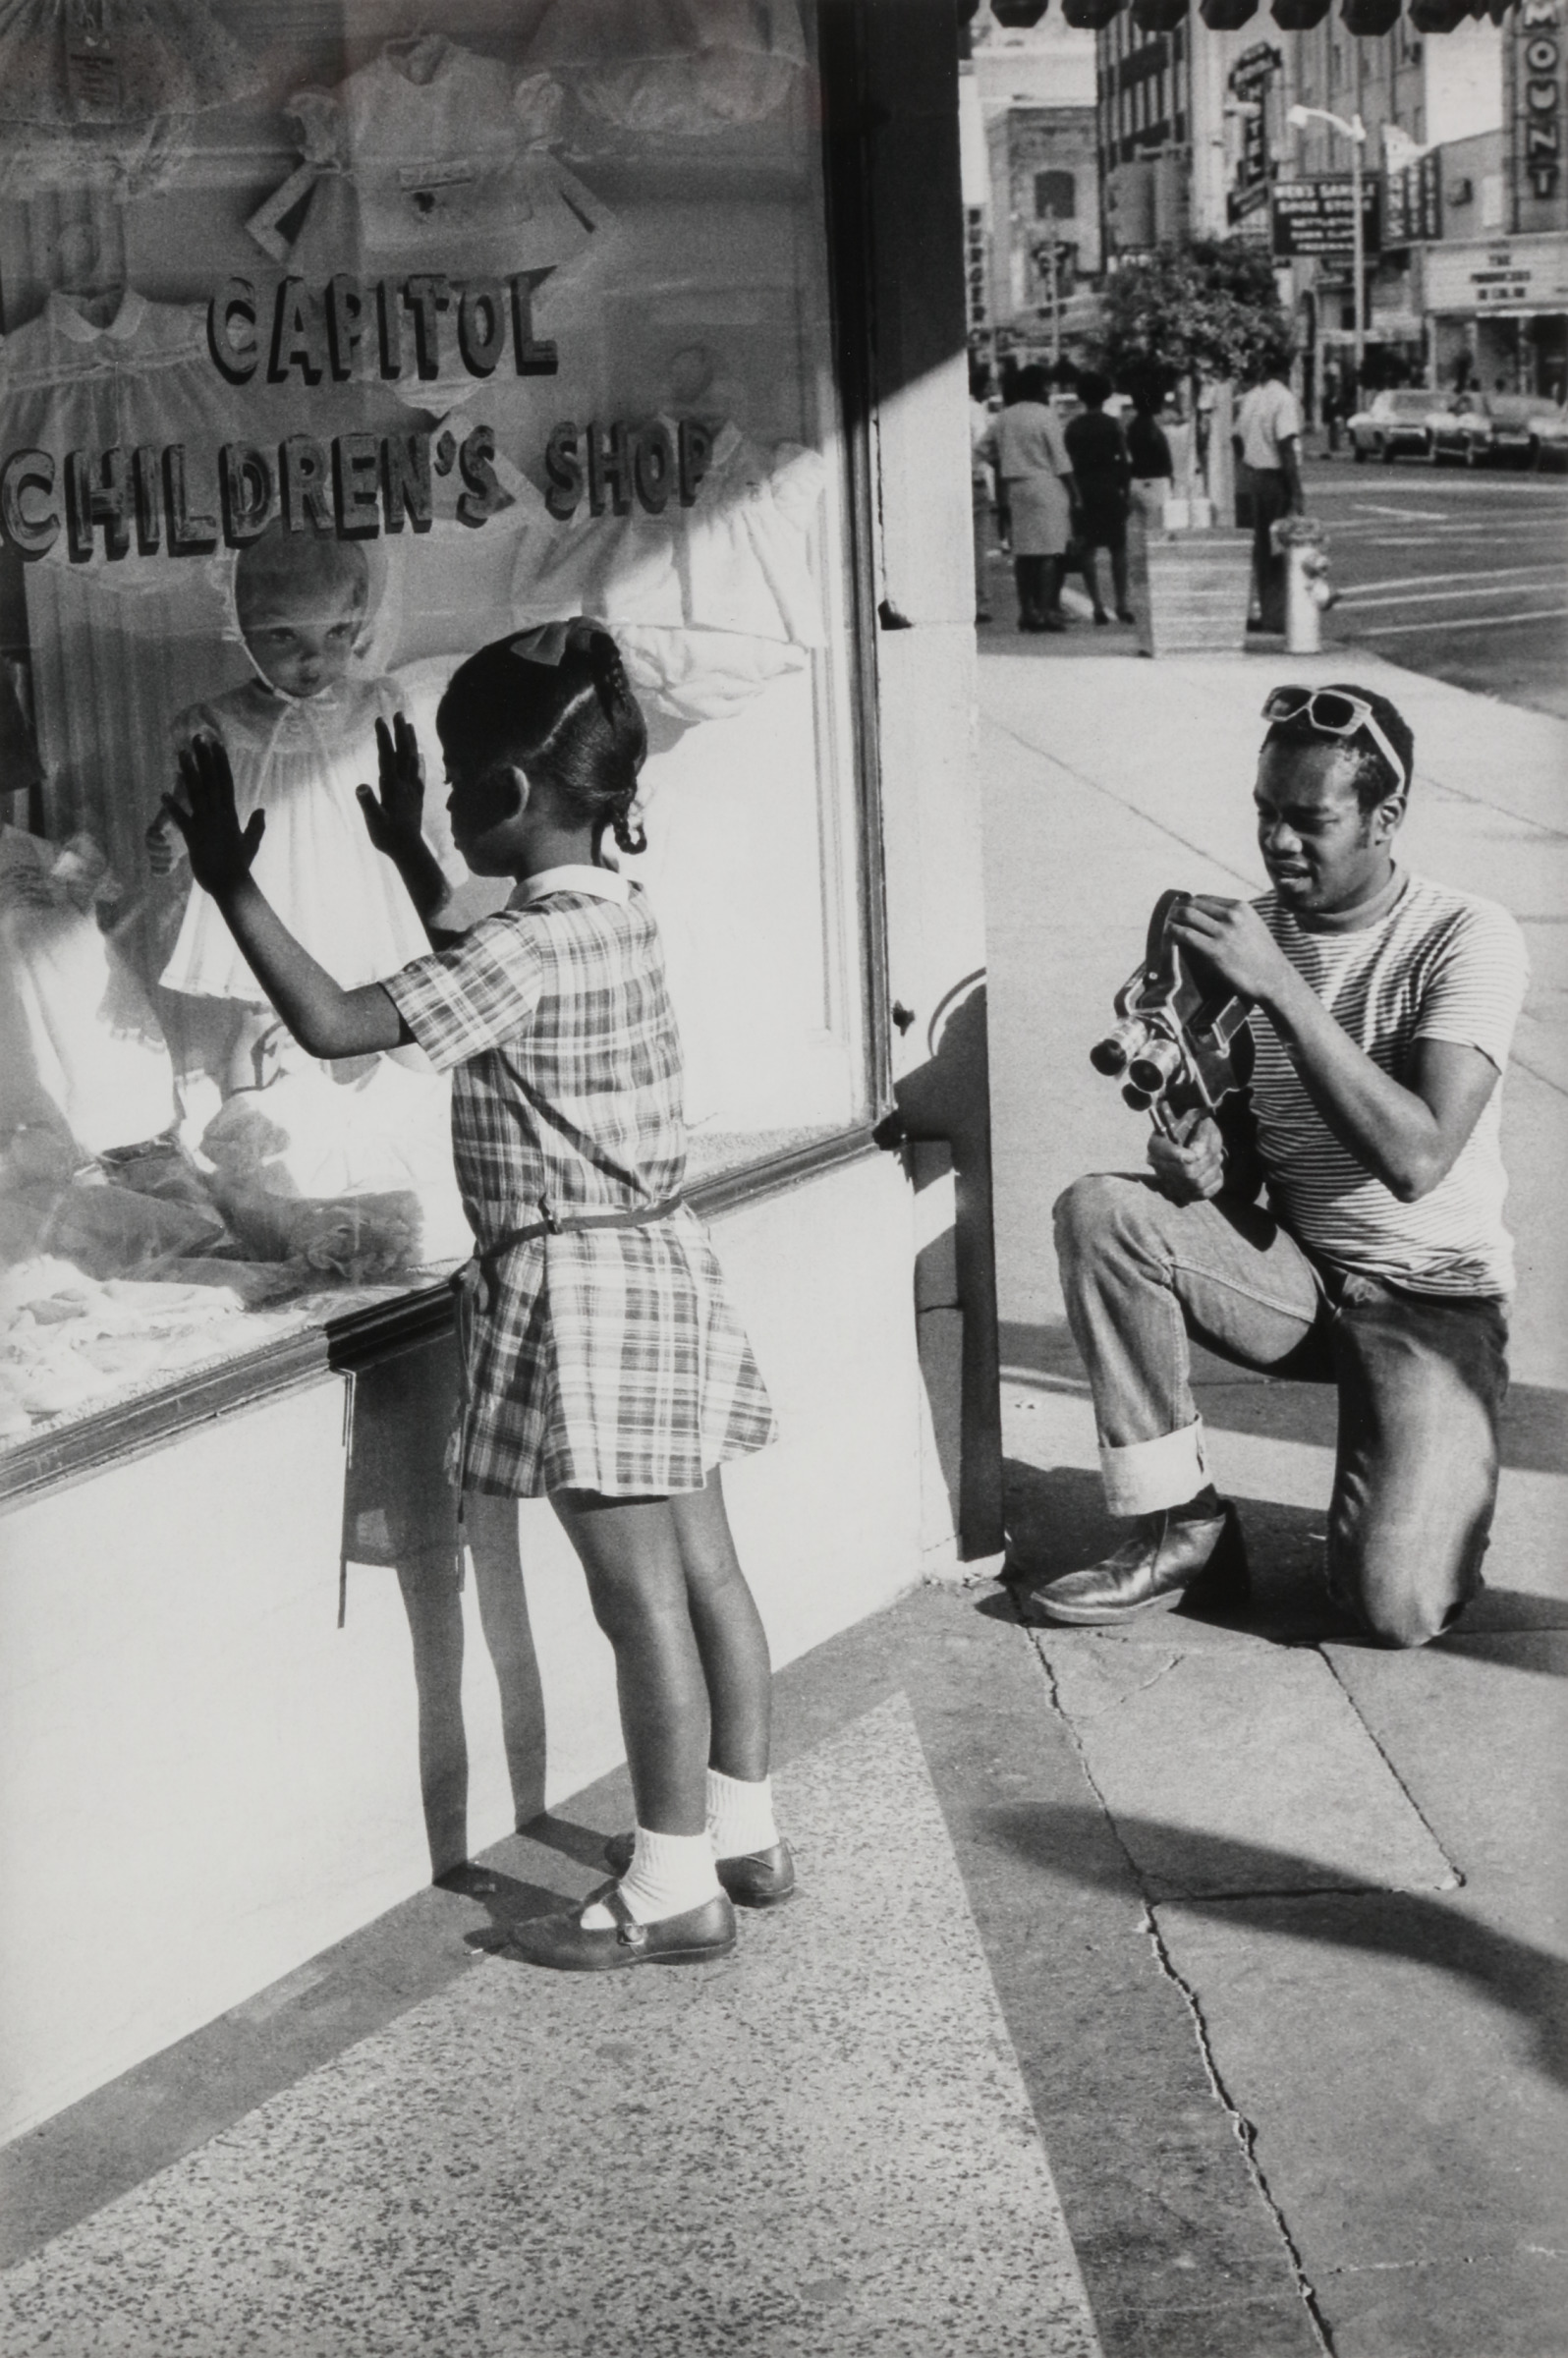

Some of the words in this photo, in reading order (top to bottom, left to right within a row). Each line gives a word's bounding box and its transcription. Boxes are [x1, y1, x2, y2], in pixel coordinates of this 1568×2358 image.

[1319, 183, 1374, 197] SAMLE
[1324, 199, 1371, 212] STOE
[206, 271, 558, 385] CAPITOL
[0, 425, 514, 564] CHILDREN'S
[545, 420, 714, 521] SHOP
